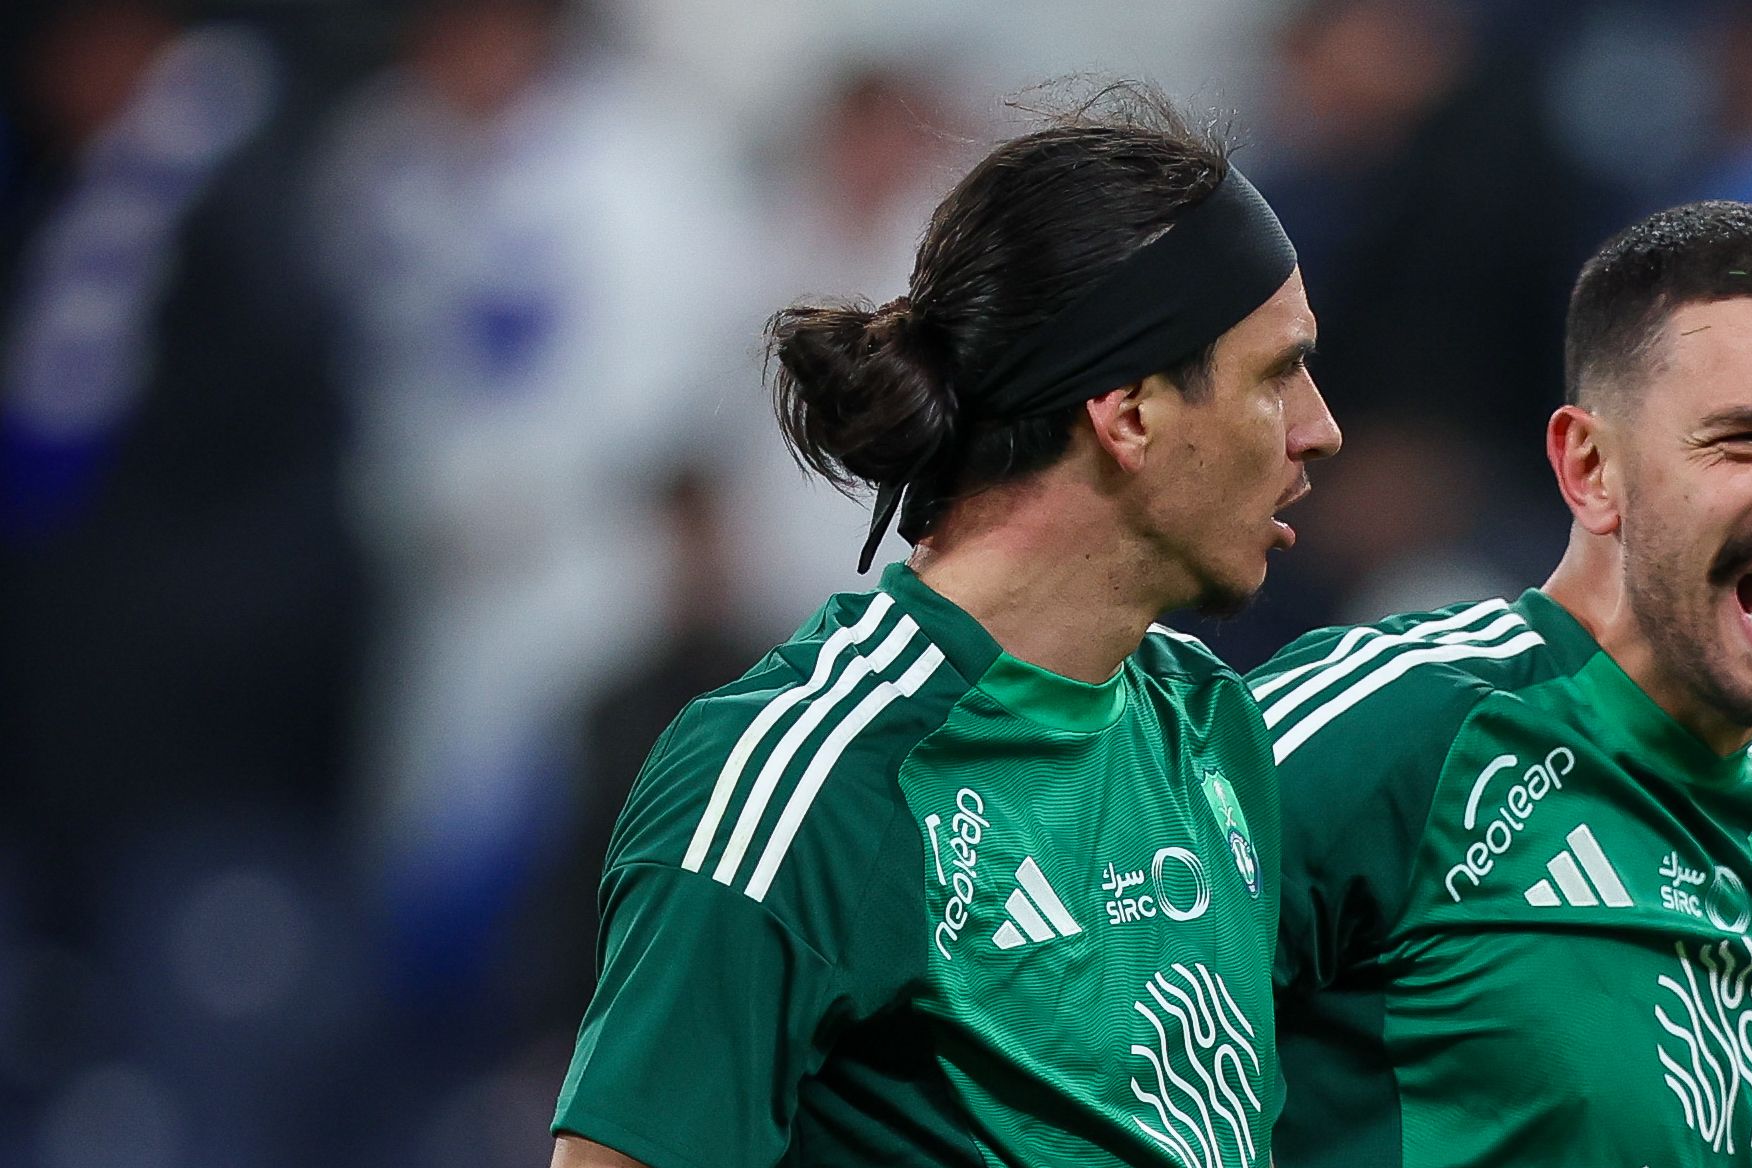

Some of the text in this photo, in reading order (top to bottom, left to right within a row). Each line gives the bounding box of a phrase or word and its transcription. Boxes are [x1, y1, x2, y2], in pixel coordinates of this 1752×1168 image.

[1445, 746, 1575, 902] neoleap
[935, 788, 990, 960] neoleap
[1101, 862, 1145, 897] سرك
[1658, 851, 1706, 887] سرك
[1106, 895, 1158, 925] SIRC
[1660, 884, 1703, 918] SIRC
